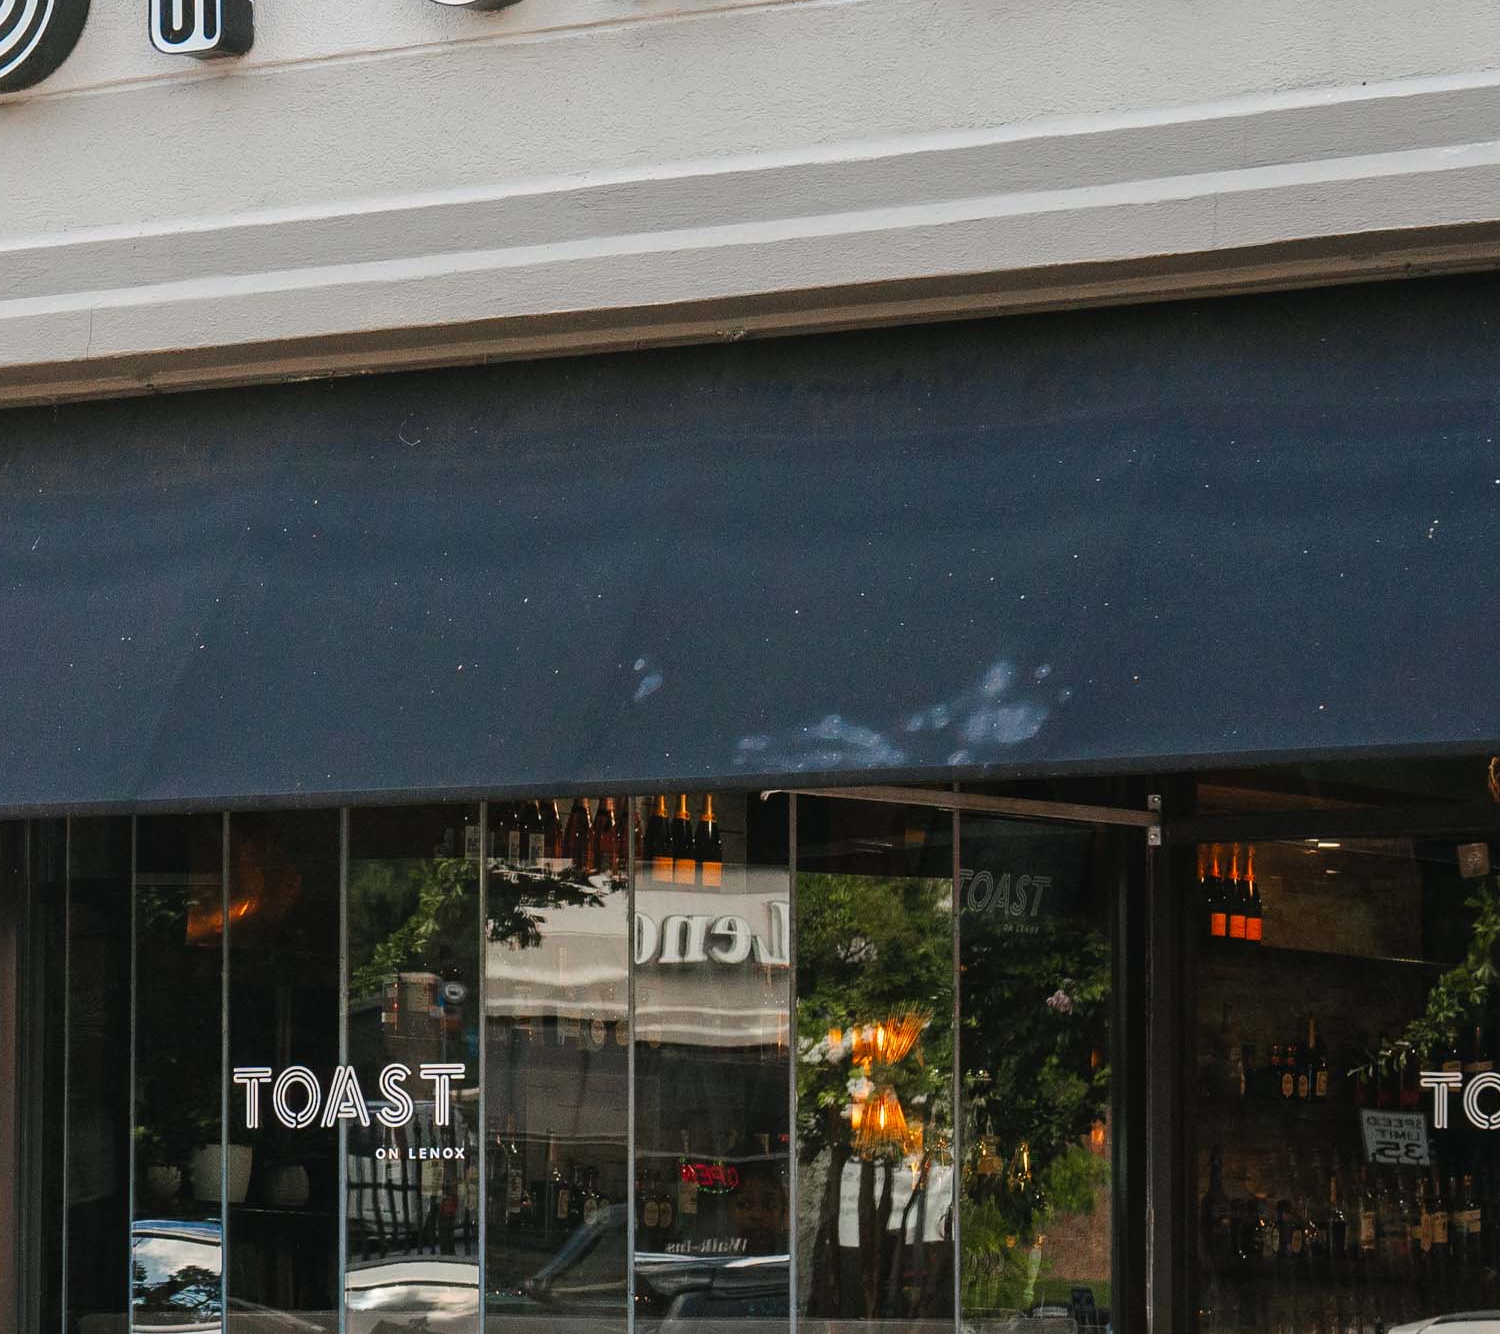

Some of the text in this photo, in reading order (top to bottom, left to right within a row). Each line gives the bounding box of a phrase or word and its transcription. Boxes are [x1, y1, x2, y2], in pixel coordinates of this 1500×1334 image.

[233, 1063, 466, 1129] TOAST
[375, 1147, 466, 1160] ON LENOX
